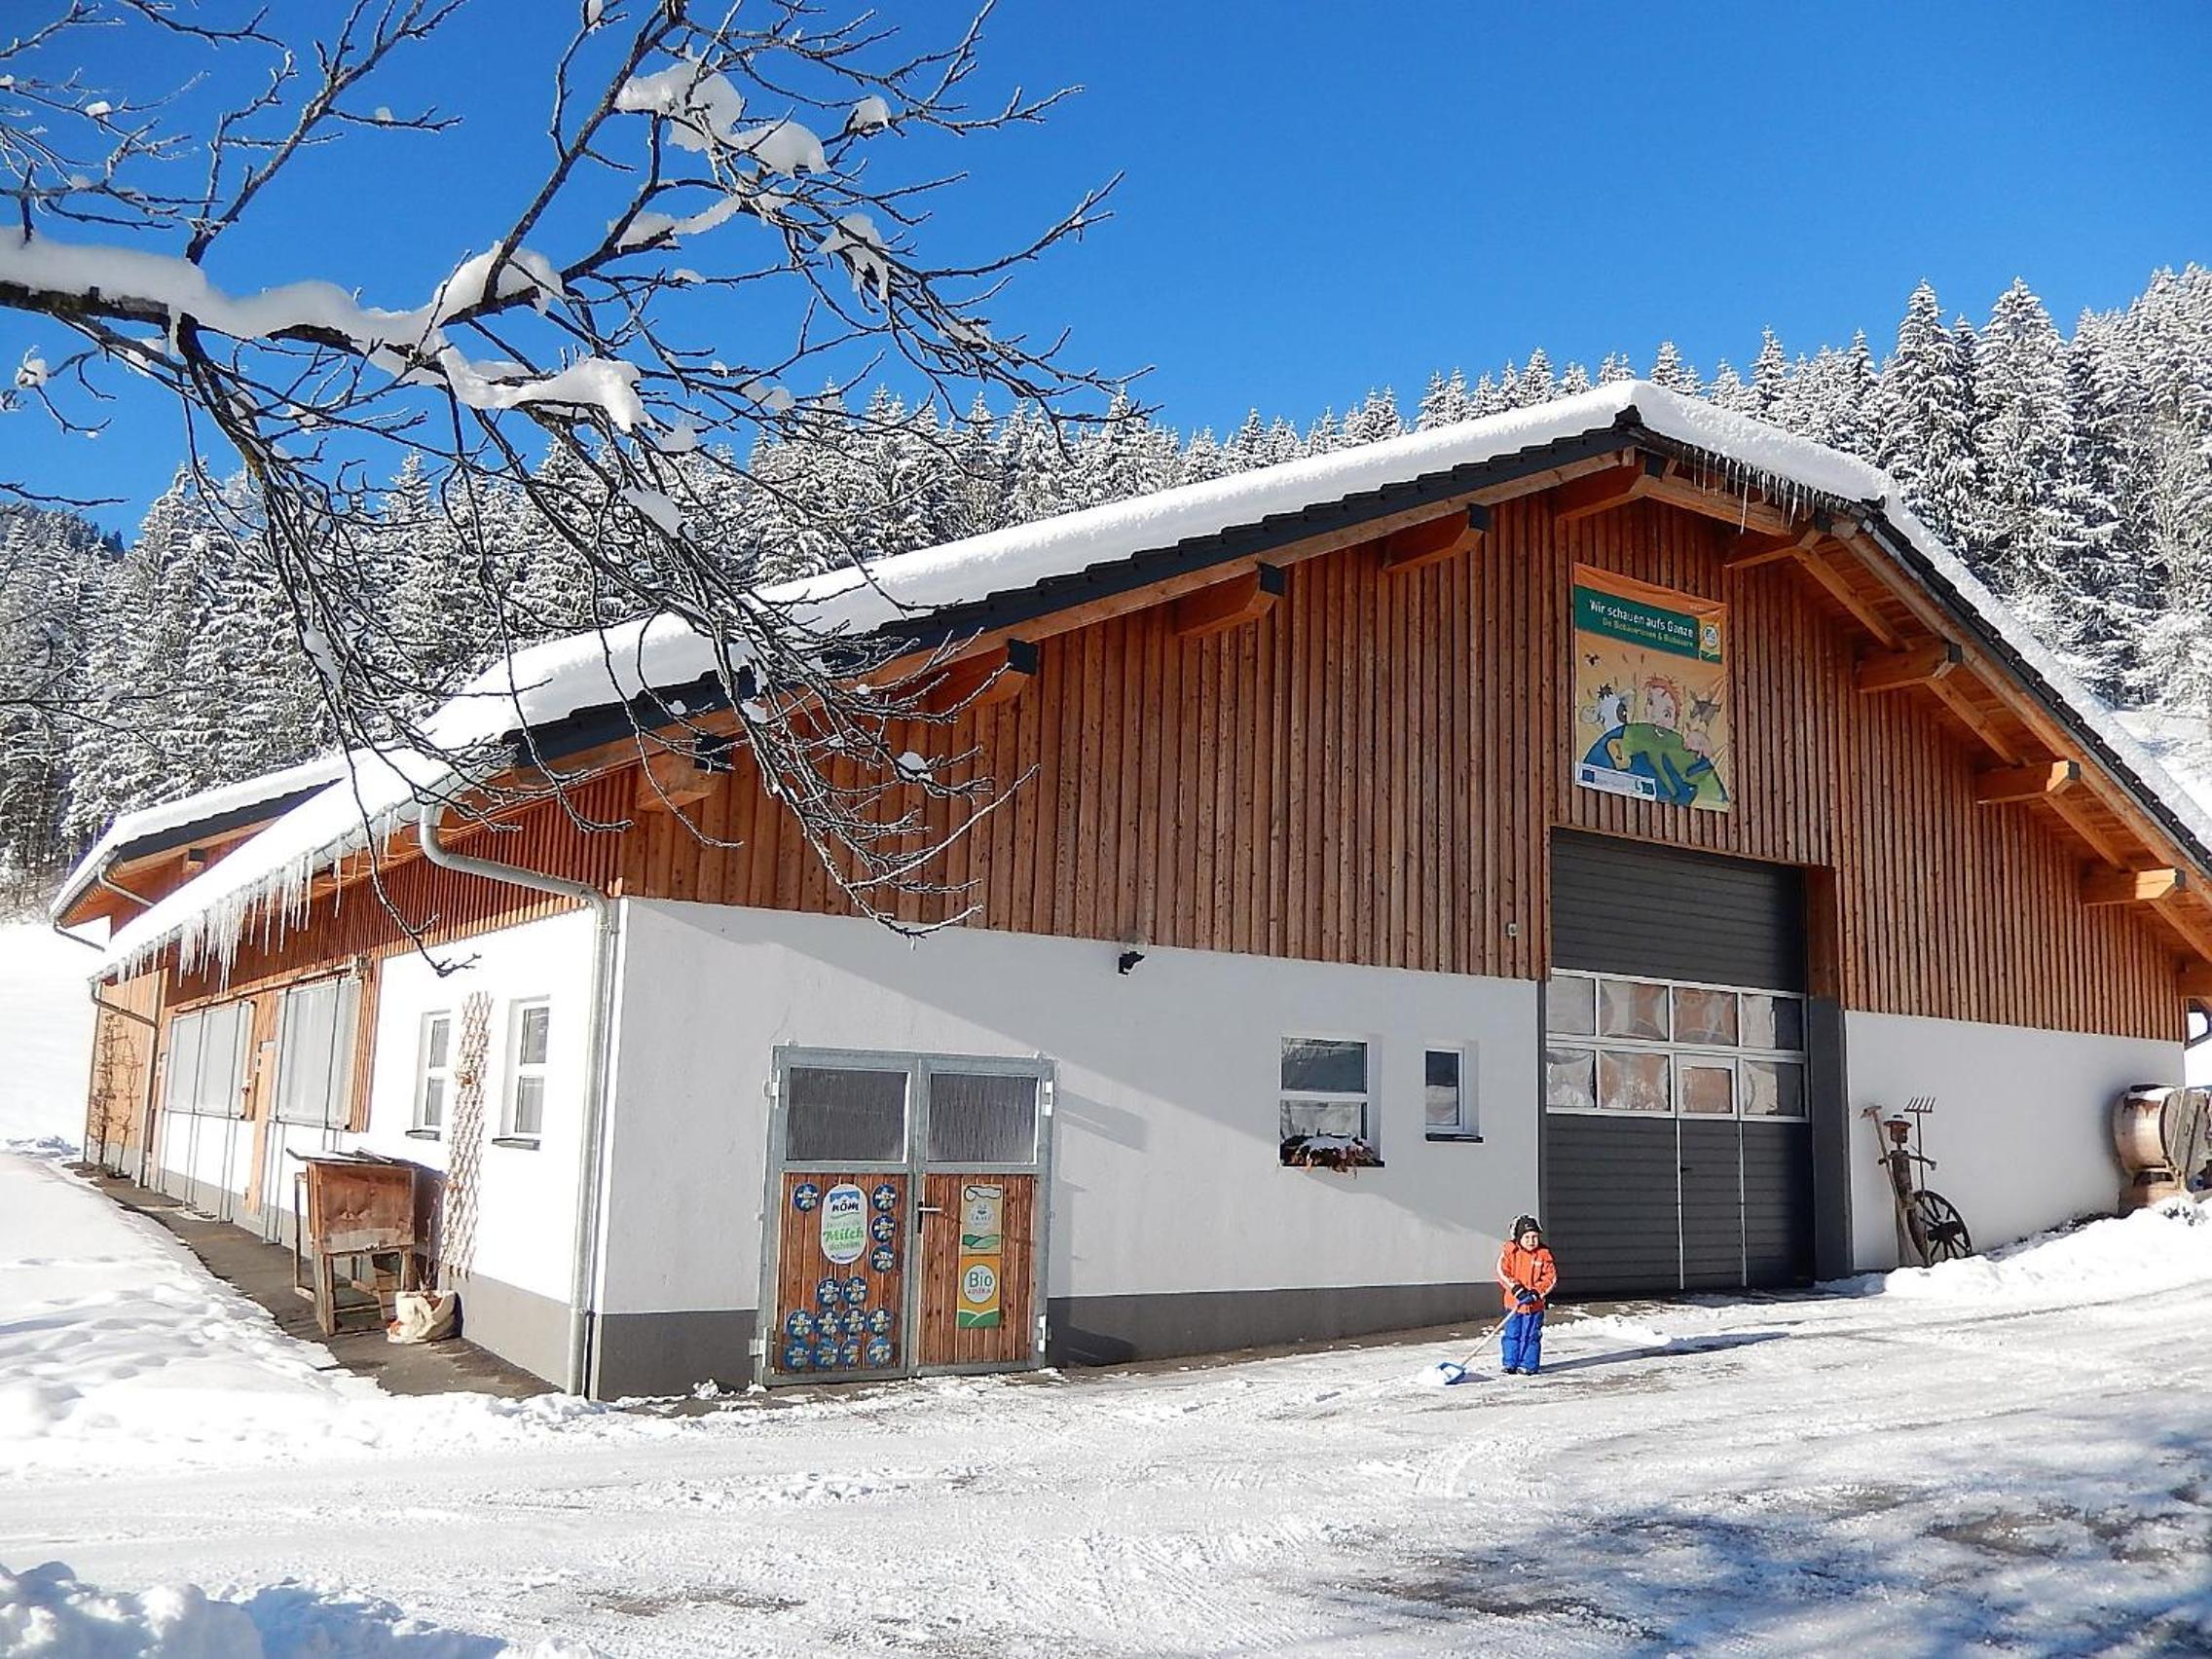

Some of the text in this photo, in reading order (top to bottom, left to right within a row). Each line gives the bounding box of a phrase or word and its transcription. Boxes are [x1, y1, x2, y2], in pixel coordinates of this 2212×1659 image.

[1589, 599, 1694, 639] Wir schauen aufs Ganze
[823, 1226, 865, 1242] Milch
[969, 1270, 993, 1288] Bio
